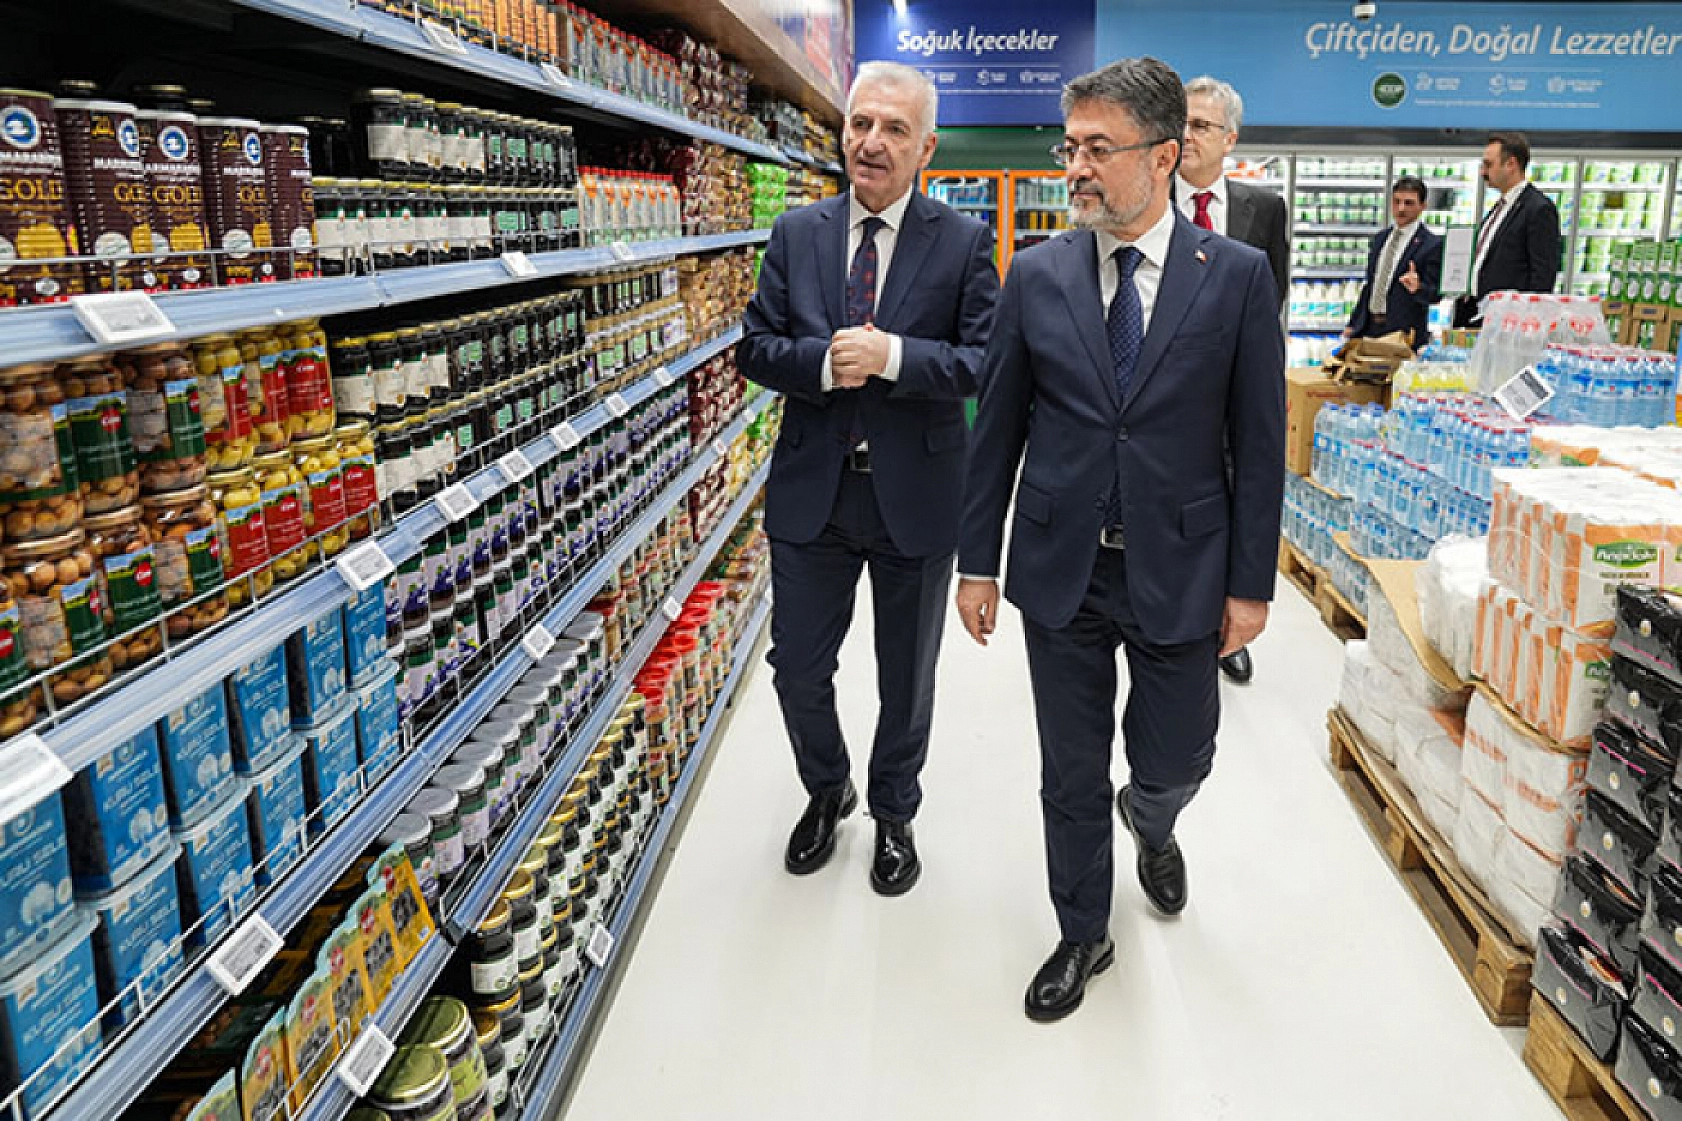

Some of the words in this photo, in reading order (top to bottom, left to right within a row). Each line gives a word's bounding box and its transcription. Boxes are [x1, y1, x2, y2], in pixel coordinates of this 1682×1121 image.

[896, 29, 963, 57] Soğuk
[965, 24, 1060, 57] İçecekler
[1305, 22, 1441, 60] Çiftçiden,
[1448, 23, 1543, 62] Doğal
[1549, 23, 1682, 56] Lezzetler
[0, 178, 64, 201] GOLD
